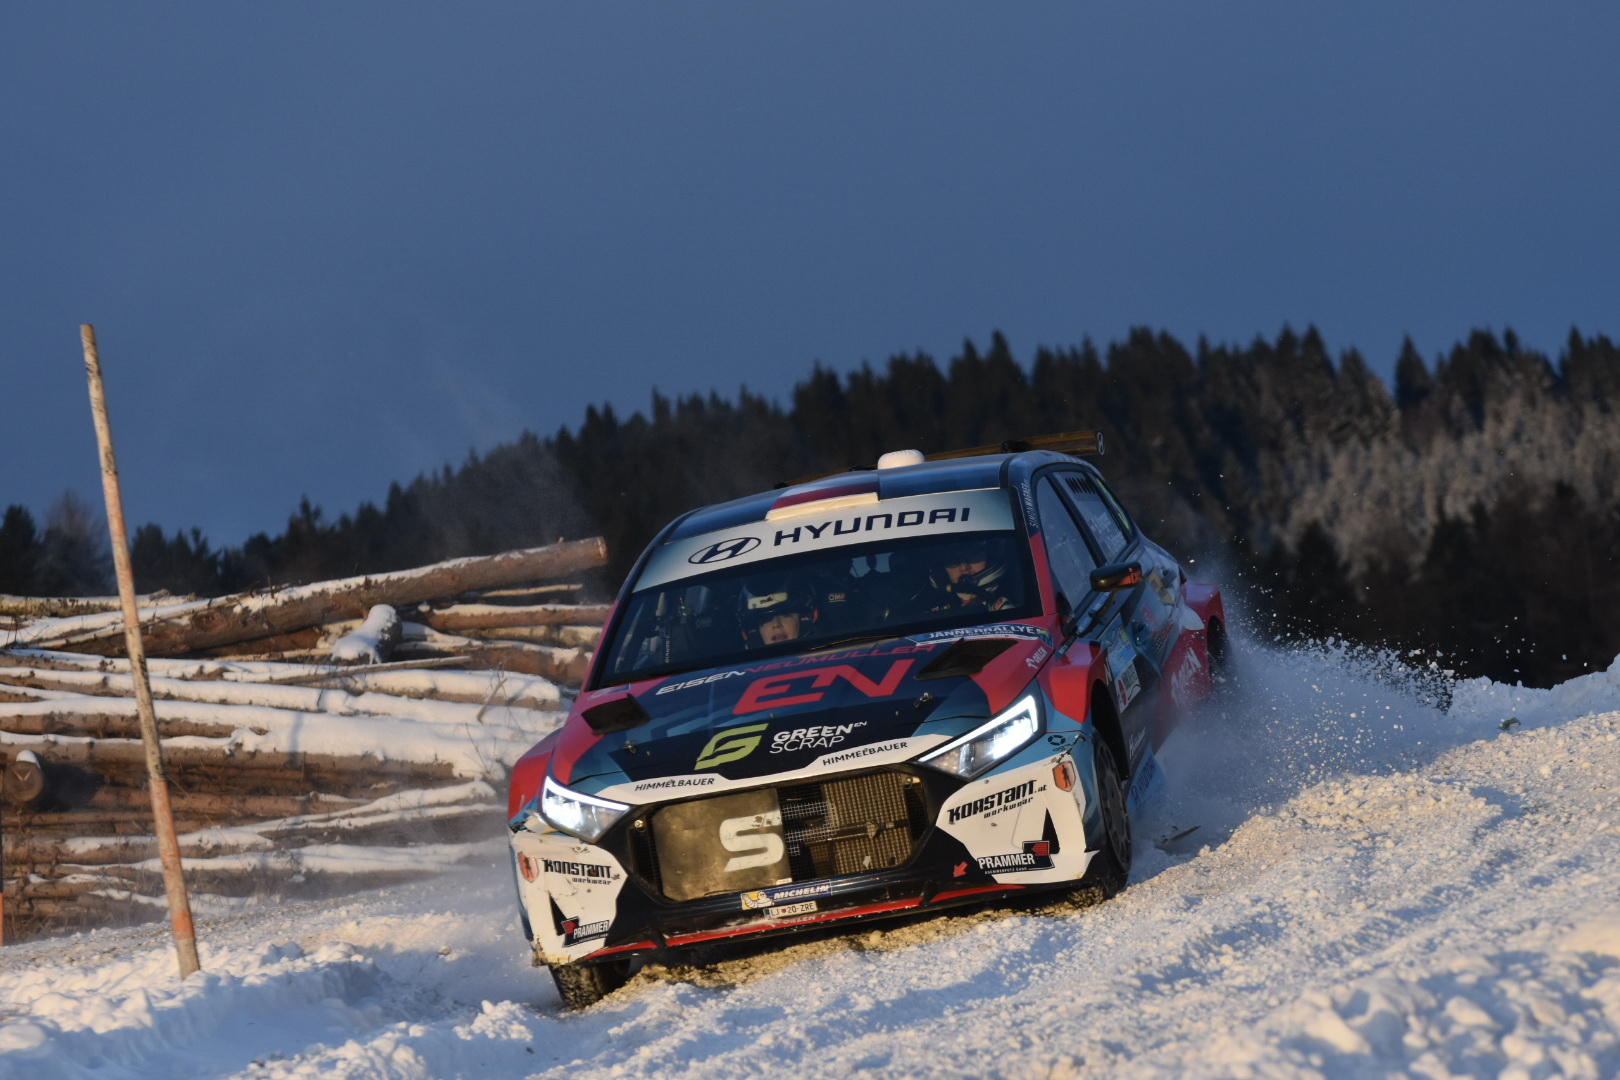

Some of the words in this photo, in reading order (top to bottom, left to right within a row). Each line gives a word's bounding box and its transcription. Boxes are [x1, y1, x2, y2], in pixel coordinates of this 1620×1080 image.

[774, 507, 970, 547] HYUNDAI
[732, 658, 916, 715] EN
[773, 723, 853, 742] GREEN
[769, 735, 845, 754] SCRAP
[822, 741, 908, 766] HIMMELBAUER
[634, 777, 715, 791] HIMMELBAUER
[983, 797, 1033, 819] workwear
[977, 853, 1036, 870] PRAMMER
[773, 884, 829, 900] MICHELIN
[573, 920, 609, 940] PRAMMER
